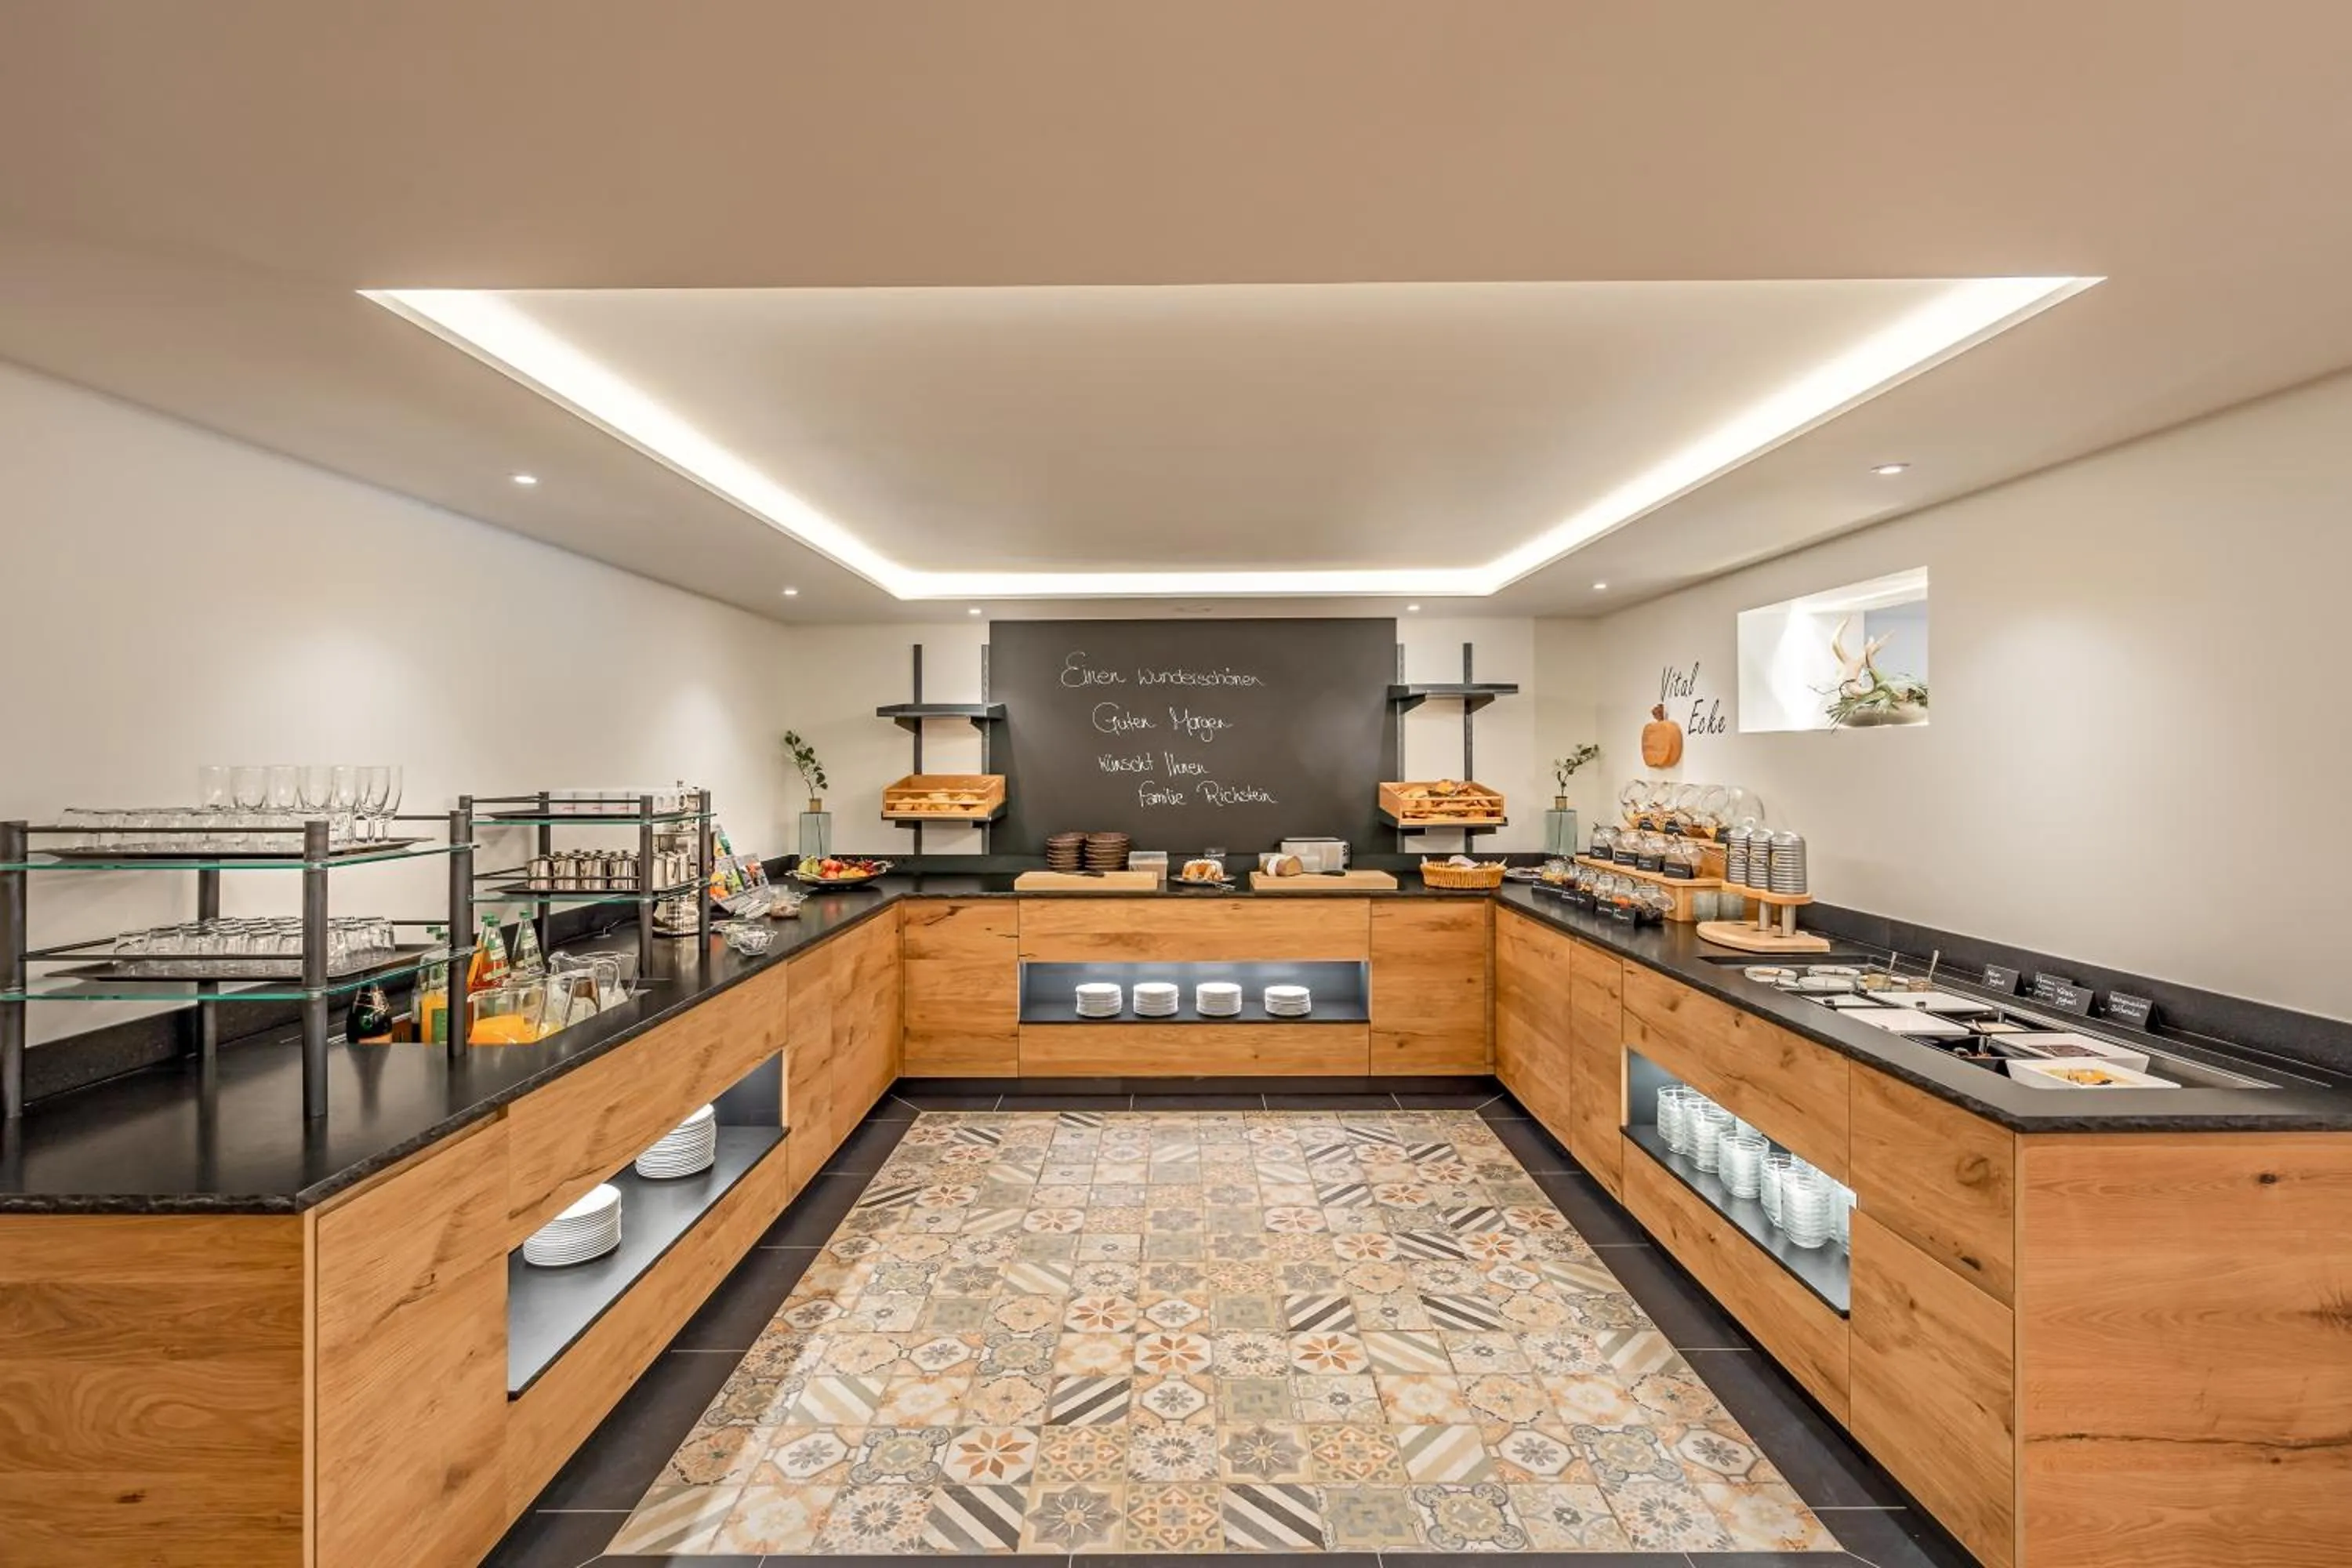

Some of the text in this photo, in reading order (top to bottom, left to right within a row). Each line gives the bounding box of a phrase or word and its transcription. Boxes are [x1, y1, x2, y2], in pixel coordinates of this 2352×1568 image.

[1061, 652, 1127, 688] Einen
[1661, 661, 1699, 702] Vital
[1092, 702, 1234, 742] Guten Morgen
[1688, 699, 1726, 735] Ecke
[1164, 751, 1210, 777] Ihnen
[1138, 780, 1279, 808] Familie Richstein
